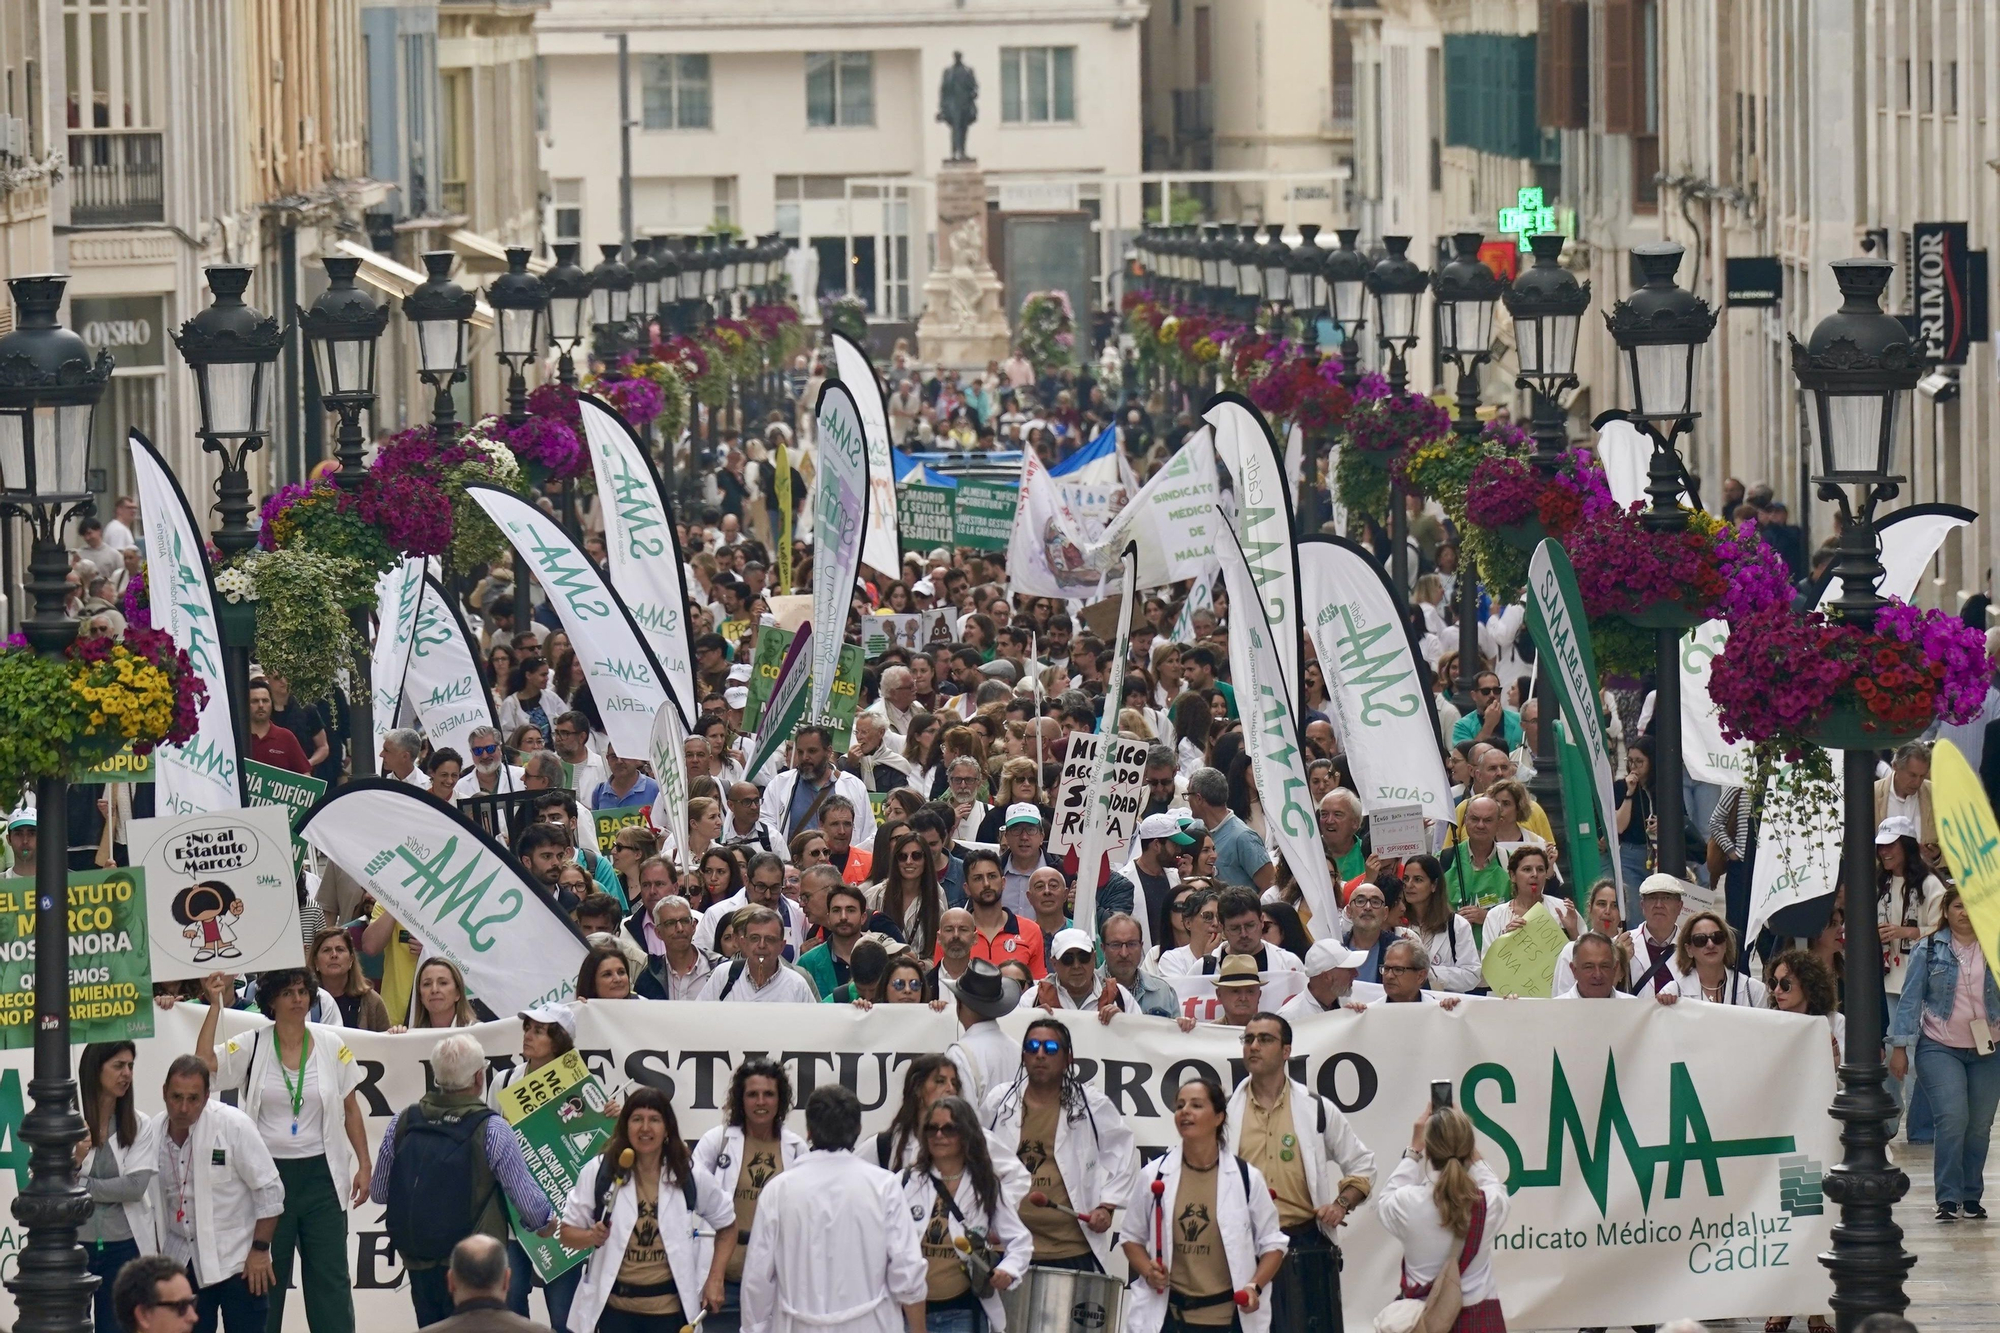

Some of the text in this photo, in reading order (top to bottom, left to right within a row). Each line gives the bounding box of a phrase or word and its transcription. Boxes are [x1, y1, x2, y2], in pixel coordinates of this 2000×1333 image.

[1919, 231, 1945, 360] PRIMOR
[1152, 482, 1213, 504] SINDICATO
[914, 513, 953, 532] MISMA
[1168, 503, 1213, 521] MÉDICO
[1189, 525, 1205, 537] DE
[185, 829, 234, 848] ¡No al
[175, 844, 248, 860] Estatuto
[184, 855, 242, 873] Marco!
[1497, 944, 1540, 997] UNA DE
[1460, 1045, 1796, 1220] SMA
[537, 1143, 565, 1178] MISMO
[1493, 1211, 1792, 1251] ndicato Médico Andaluz
[1688, 1236, 1790, 1274] Cádiz
